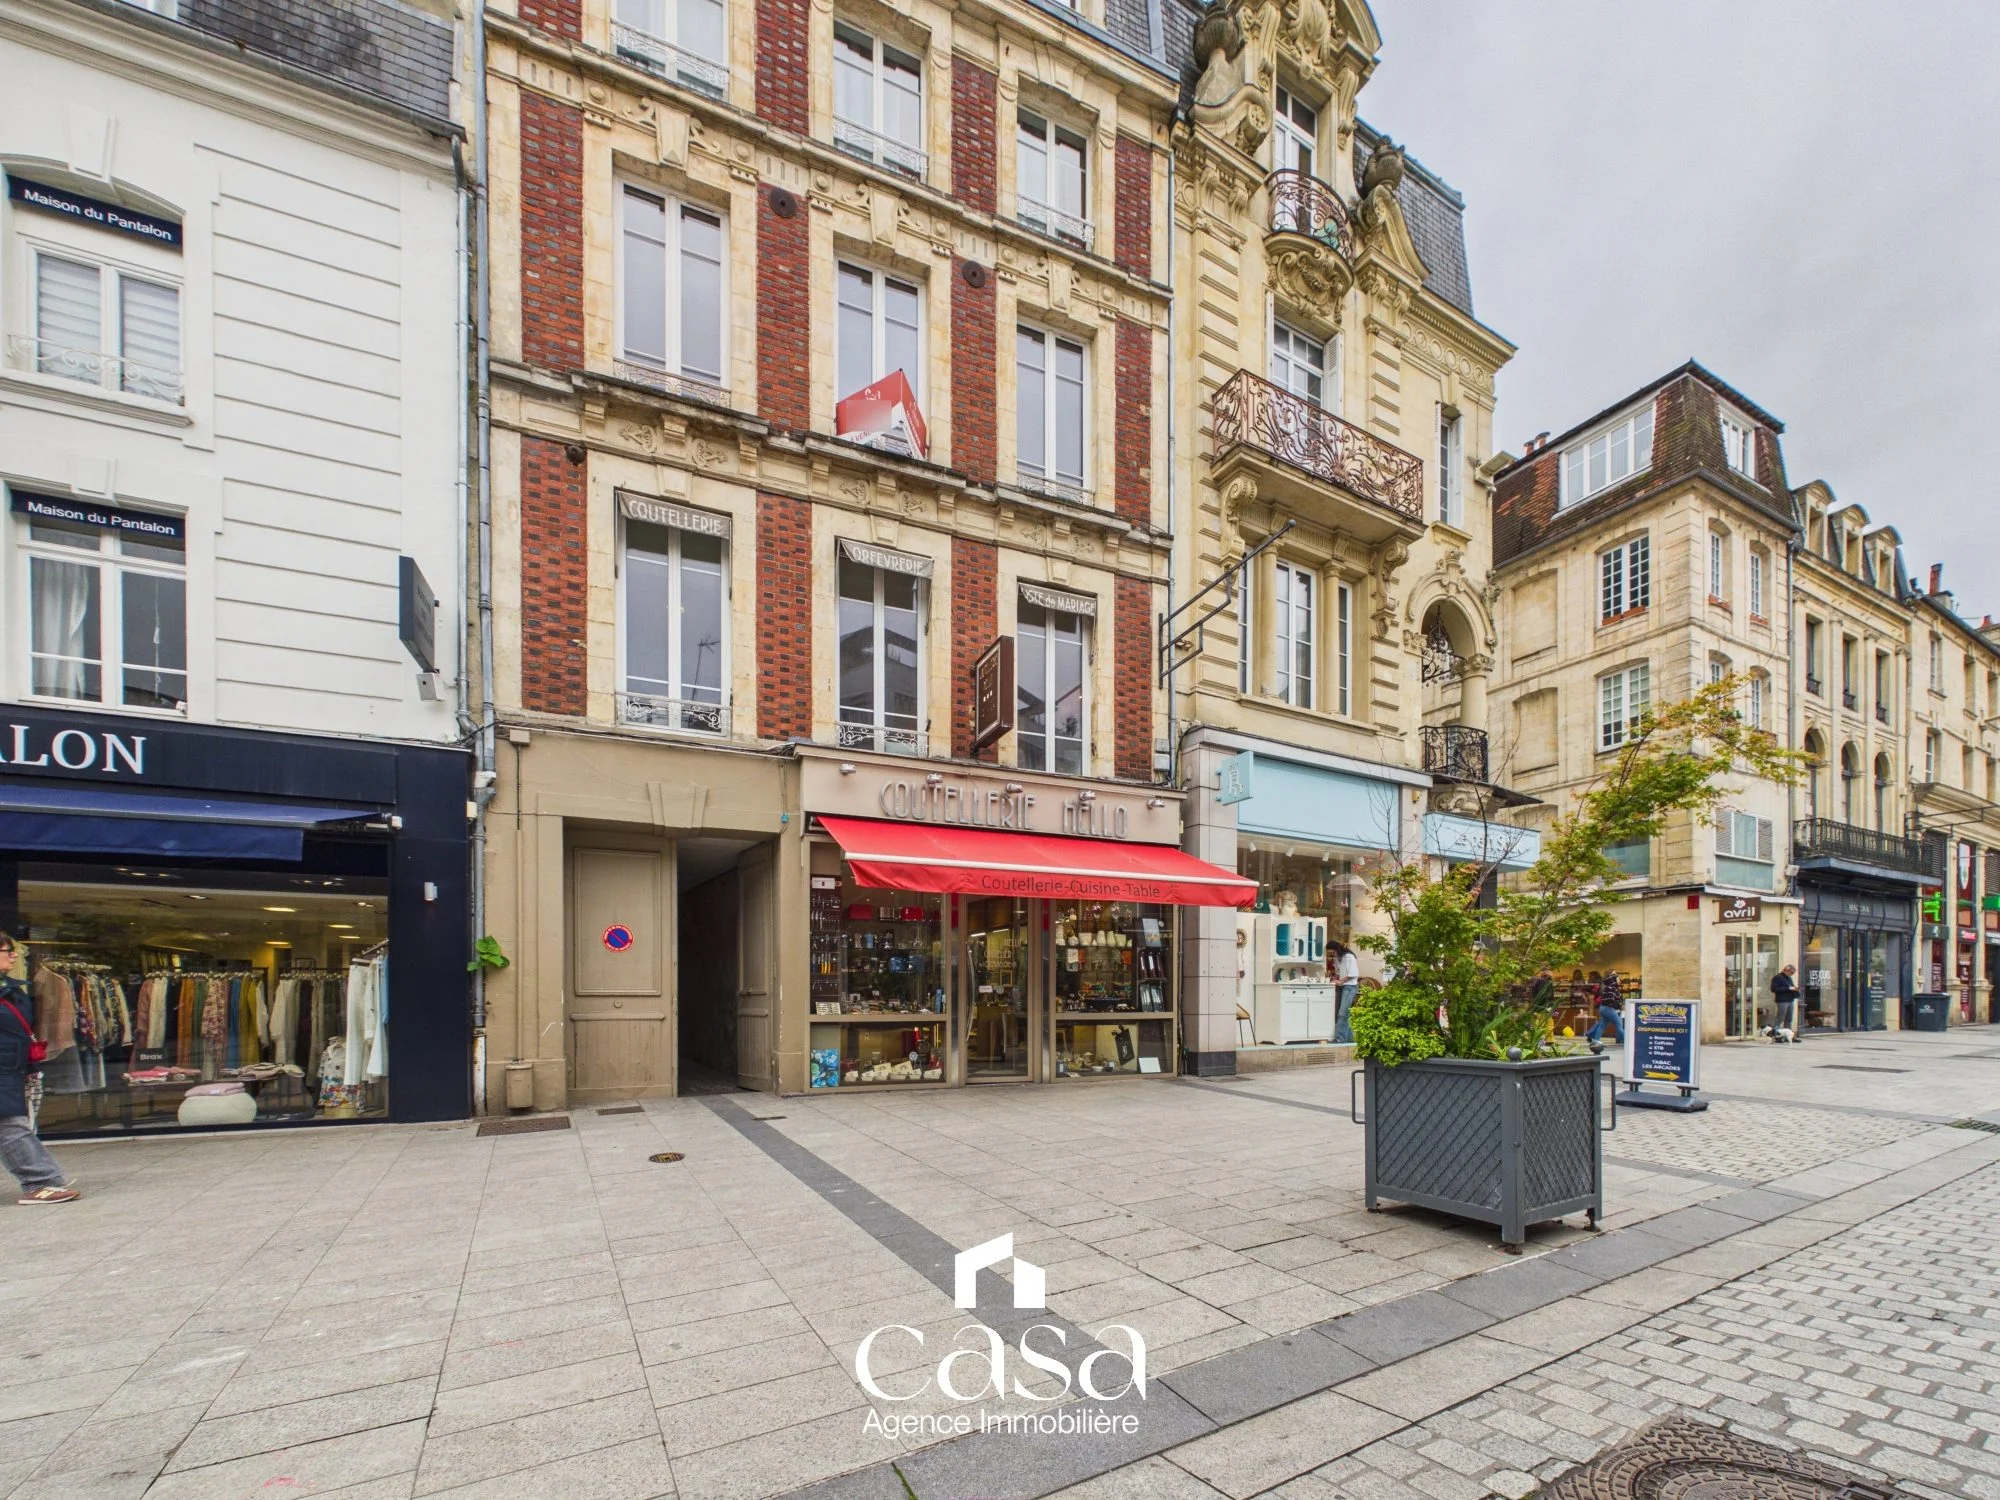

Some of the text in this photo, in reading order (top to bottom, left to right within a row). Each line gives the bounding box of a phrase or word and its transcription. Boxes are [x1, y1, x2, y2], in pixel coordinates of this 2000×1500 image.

[24, 188, 173, 241] Maison du Pantalon
[28, 501, 175, 536] Maison du Pantalon
[628, 500, 721, 535] COUTELLERIE
[852, 546, 924, 576] ORFEVRERIE
[1045, 594, 1056, 608] de
[1057, 596, 1096, 616] MARIAGE
[0, 724, 147, 775] LON
[880, 779, 1036, 831] COUTELLERIE
[1724, 906, 1755, 918] avril
